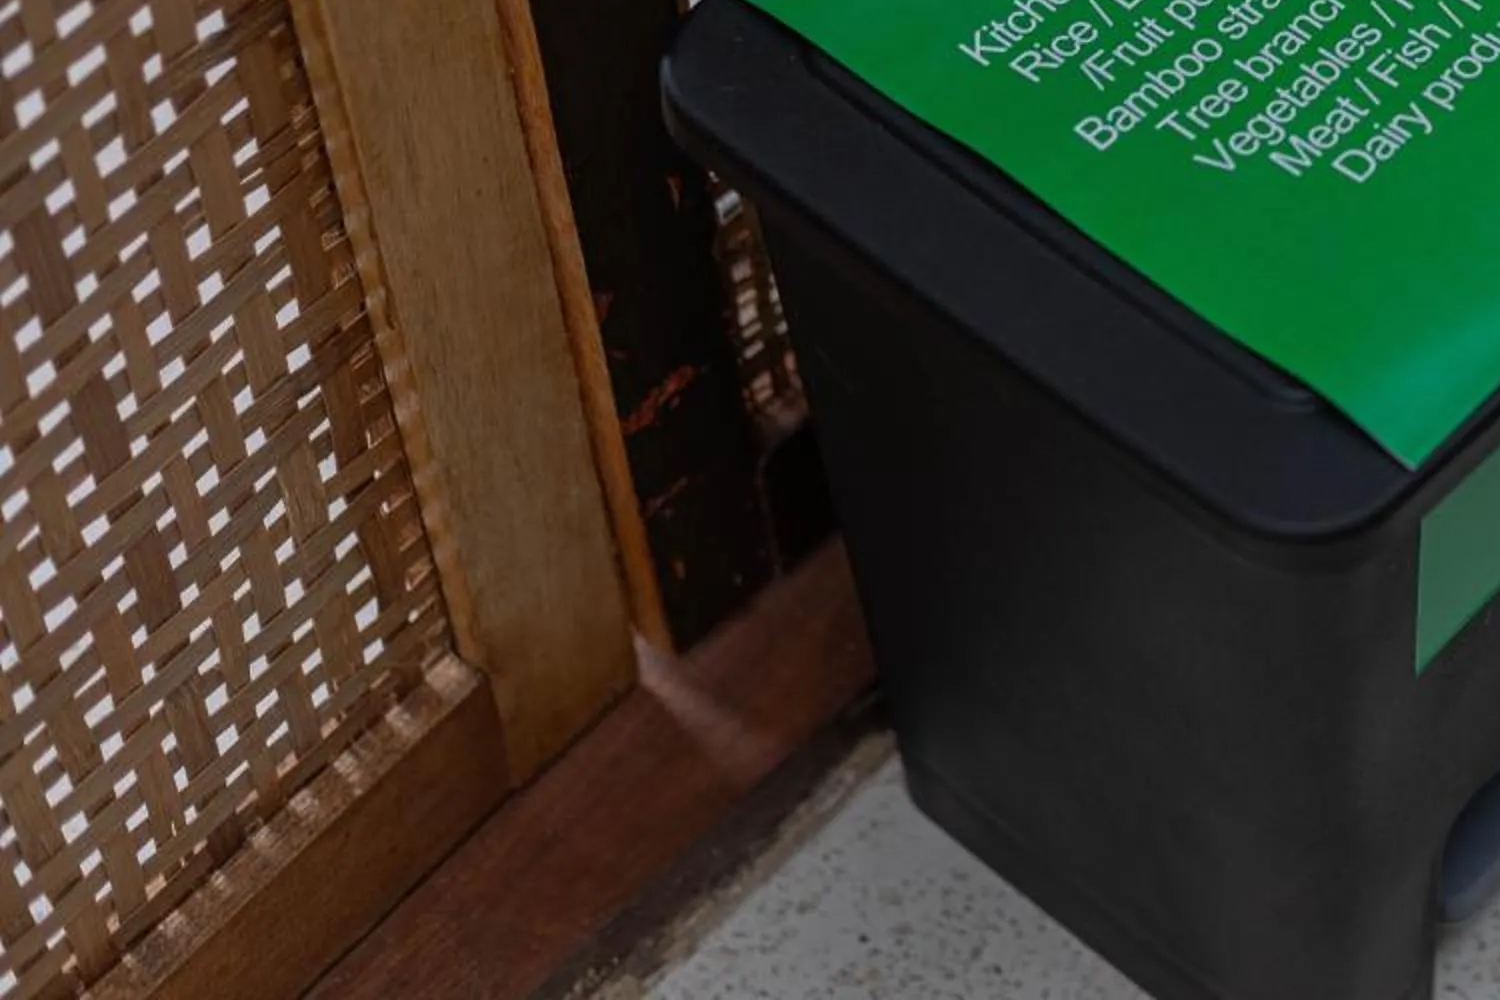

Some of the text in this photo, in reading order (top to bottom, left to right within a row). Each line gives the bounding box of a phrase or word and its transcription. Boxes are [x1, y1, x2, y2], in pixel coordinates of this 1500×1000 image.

[1437, 0, 1464, 29] /
[1009, 21, 1099, 83] Rice
[1366, 23, 1452, 88] Fish
[1073, 38, 1223, 151] Bamboo
[1155, 78, 1249, 140] Tree
[1193, 23, 1383, 171] Vegetables
[1370, 0, 1397, 29] /
[1353, 77, 1381, 106] /
[1268, 96, 1370, 177] Meat
[1331, 102, 1433, 183] Dairy
